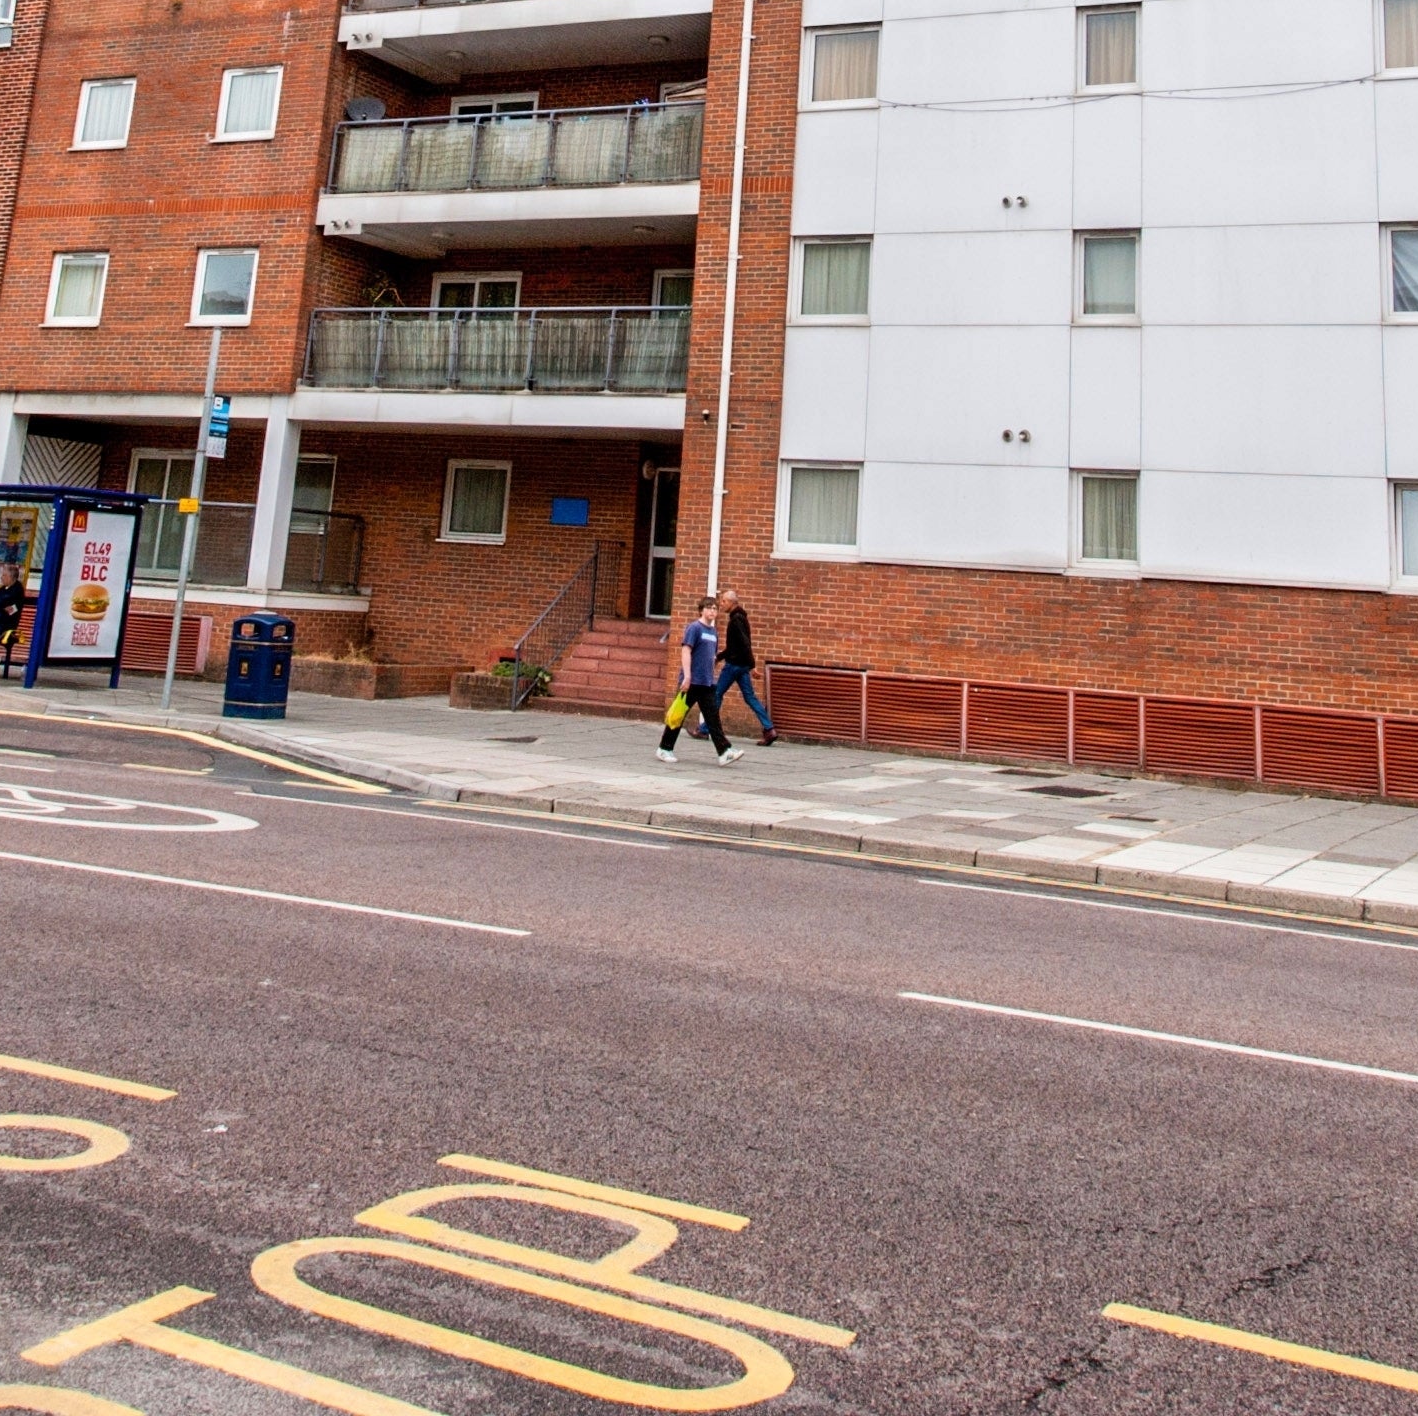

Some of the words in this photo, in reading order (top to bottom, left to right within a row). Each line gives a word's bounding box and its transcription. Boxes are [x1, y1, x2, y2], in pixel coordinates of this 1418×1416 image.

[84, 541, 112, 556] £1.49
[83, 555, 110, 564] CHICKEN
[81, 565, 108, 582] BLC
[73, 622, 100, 634] SAVER
[71, 632, 98, 646] MENU
